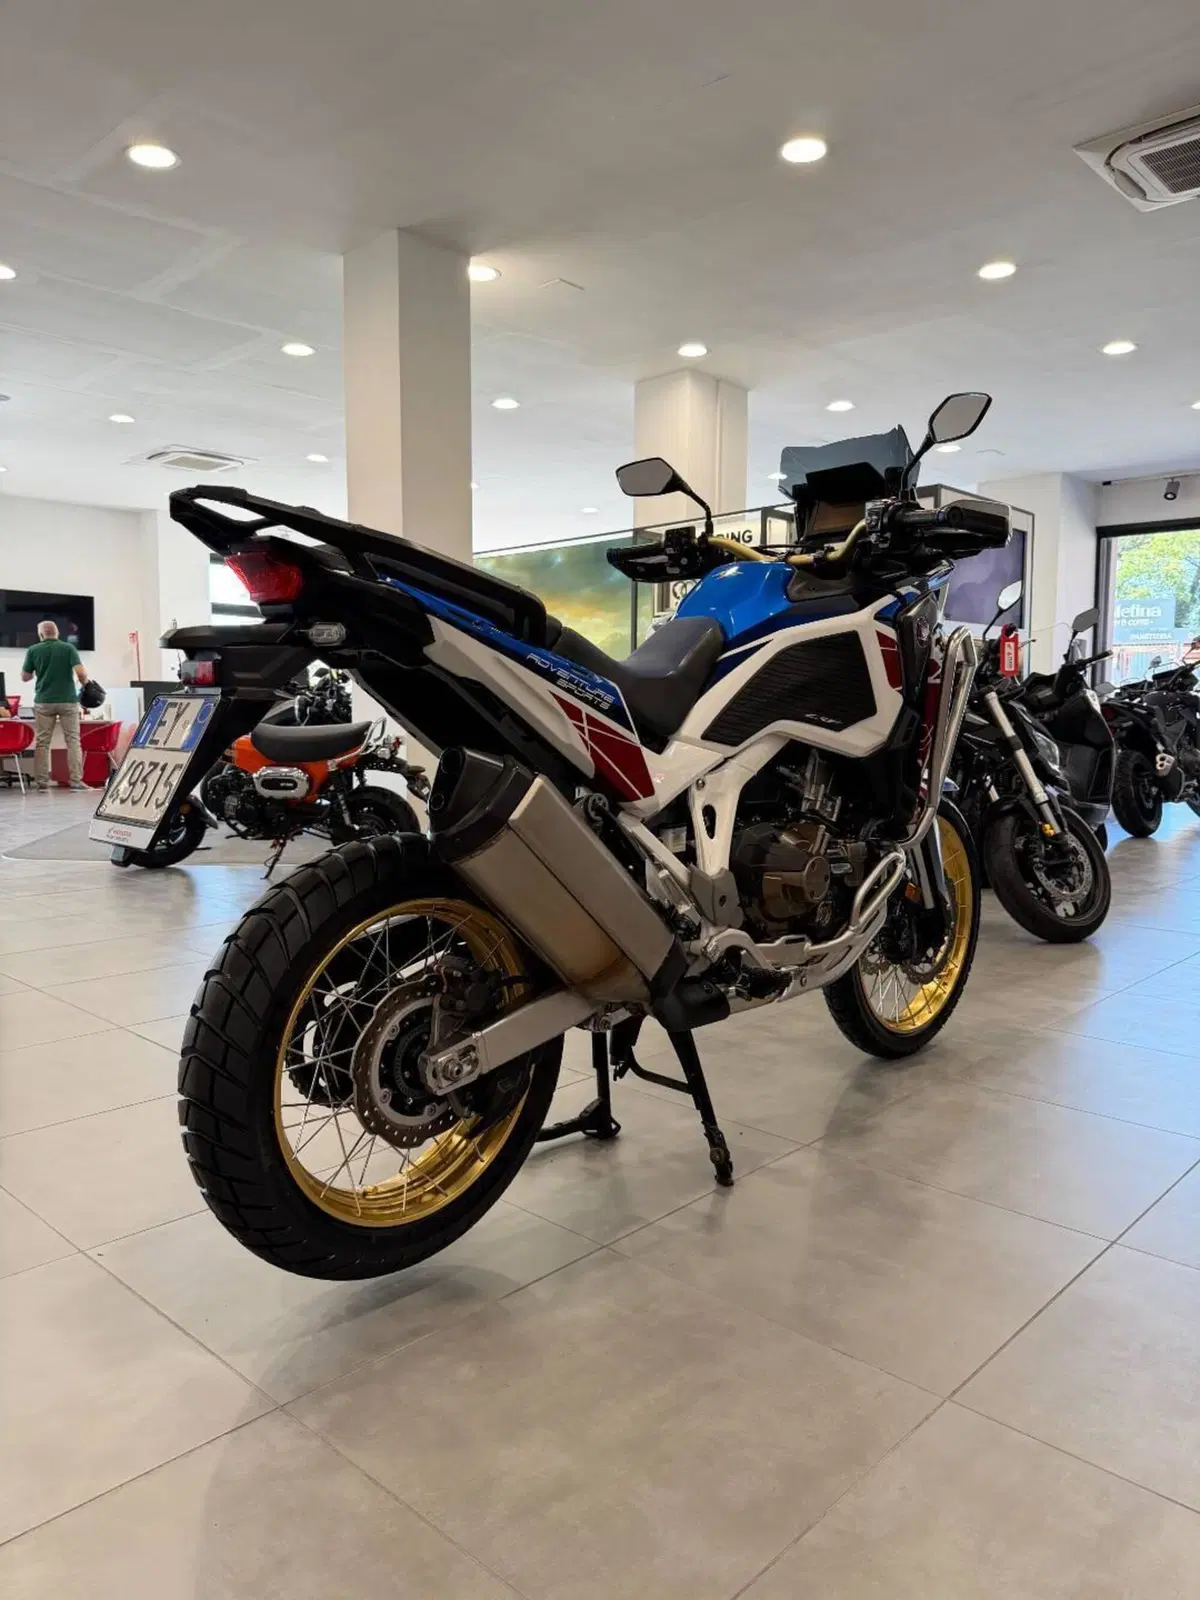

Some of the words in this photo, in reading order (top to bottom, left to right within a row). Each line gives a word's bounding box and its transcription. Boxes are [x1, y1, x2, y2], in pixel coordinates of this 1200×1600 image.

[526, 652, 615, 704] ADVENTURE
[556, 678, 611, 710] SPORTS
[149, 701, 190, 746] EY
